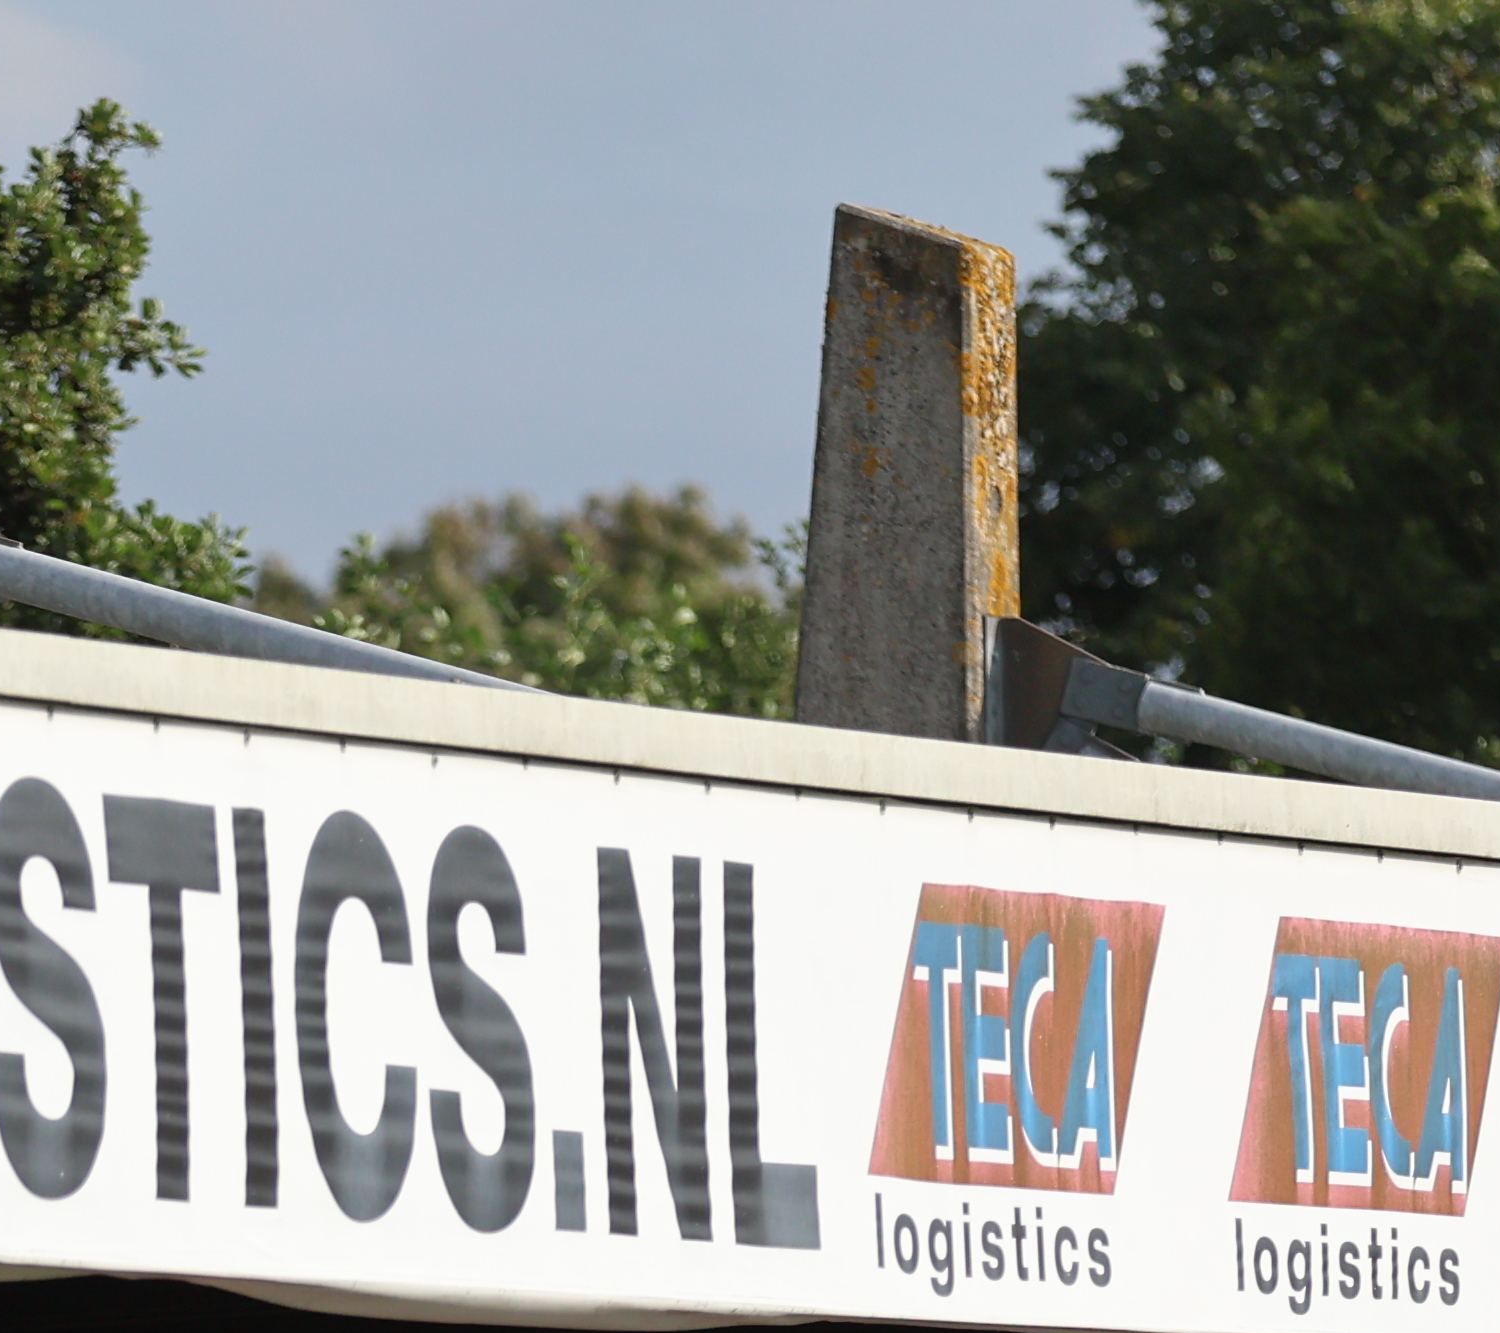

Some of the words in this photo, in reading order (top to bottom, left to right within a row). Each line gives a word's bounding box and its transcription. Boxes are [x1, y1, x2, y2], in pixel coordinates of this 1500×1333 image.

[914, 922, 1116, 1171] TECA
[1272, 953, 1467, 1194] TECA
[874, 1194, 1111, 1297] logistics
[1235, 1218, 1461, 1315] logistics
